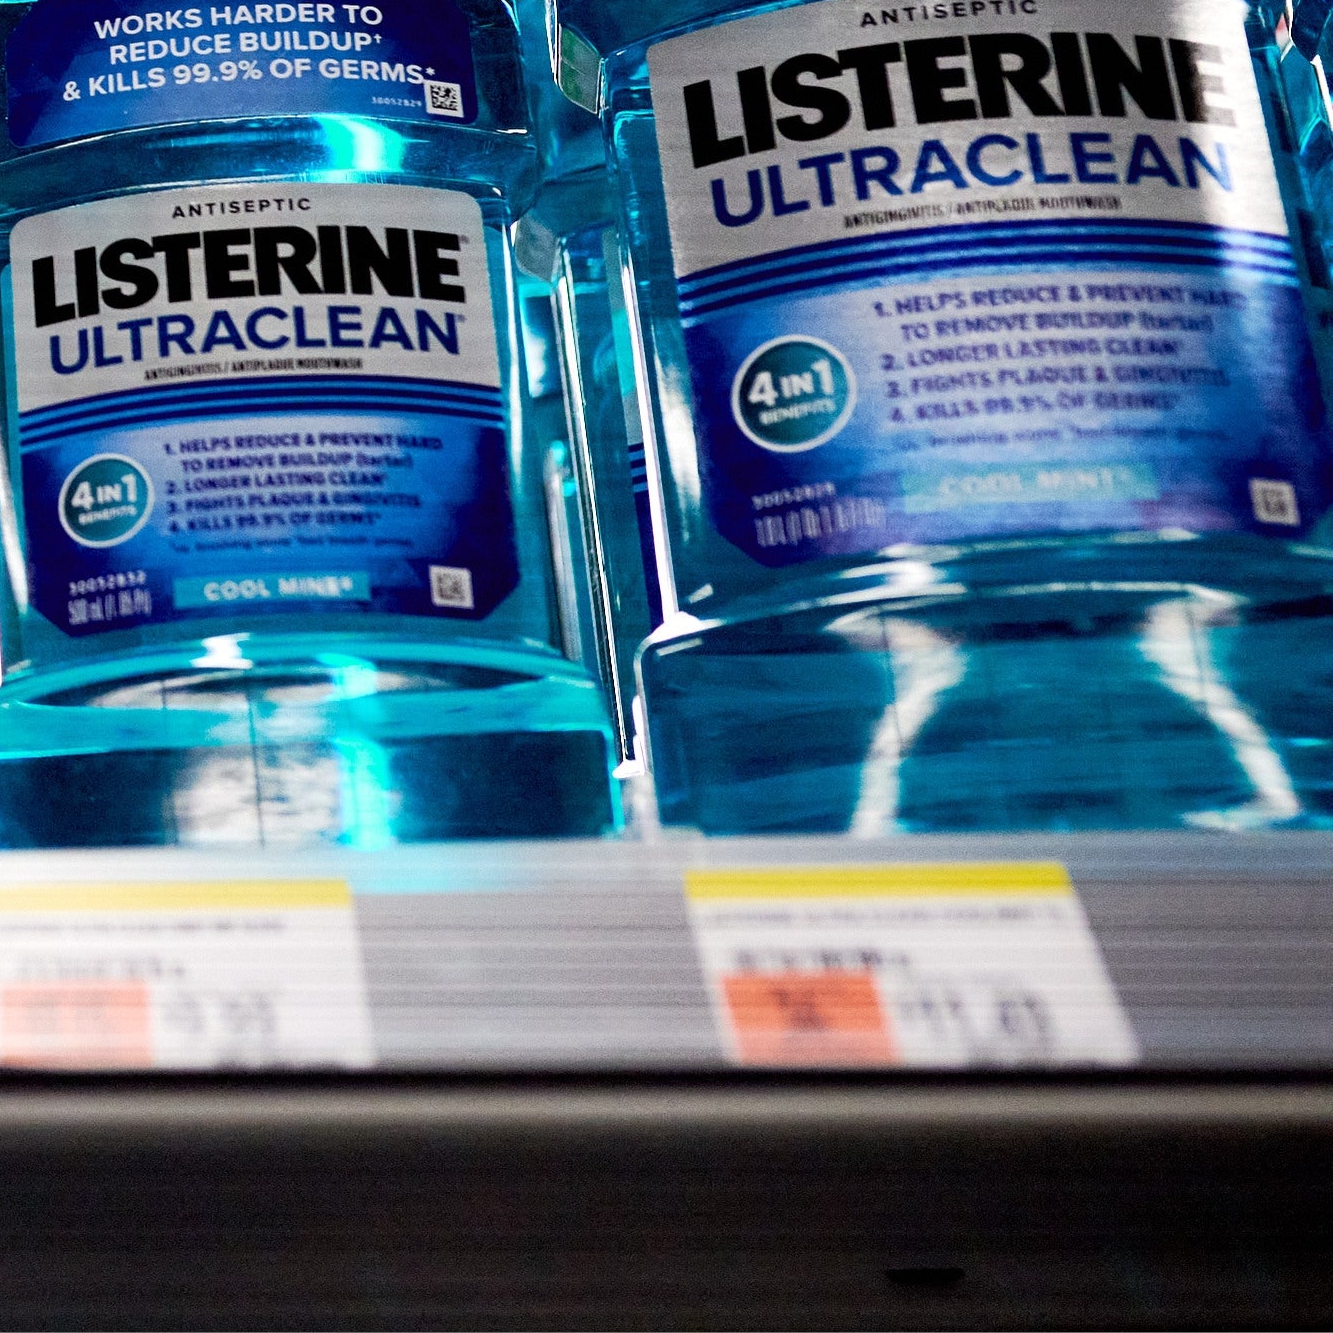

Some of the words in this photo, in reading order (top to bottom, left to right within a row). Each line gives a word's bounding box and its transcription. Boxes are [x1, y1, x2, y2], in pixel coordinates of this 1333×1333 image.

[93, 8, 203, 40] WORKS
[211, 4, 336, 26] HARDER
[342, 4, 383, 26] TO
[860, 0, 1039, 27] ANTISEPTIC
[109, 34, 231, 65] REDUCE
[63, 81, 81, 102] &
[88, 68, 166, 97] KILLS
[173, 61, 263, 86] 99.9%
[269, 58, 311, 79] OF
[682, 32, 1237, 169] LISTERINE
[710, 132, 1235, 228] ULTRACLEAN
[172, 199, 312, 219] ANTISEPTIC
[32, 225, 466, 328] LISTERINE
[49, 305, 460, 375] ULTRACLEAN
[204, 580, 271, 602] COOL
